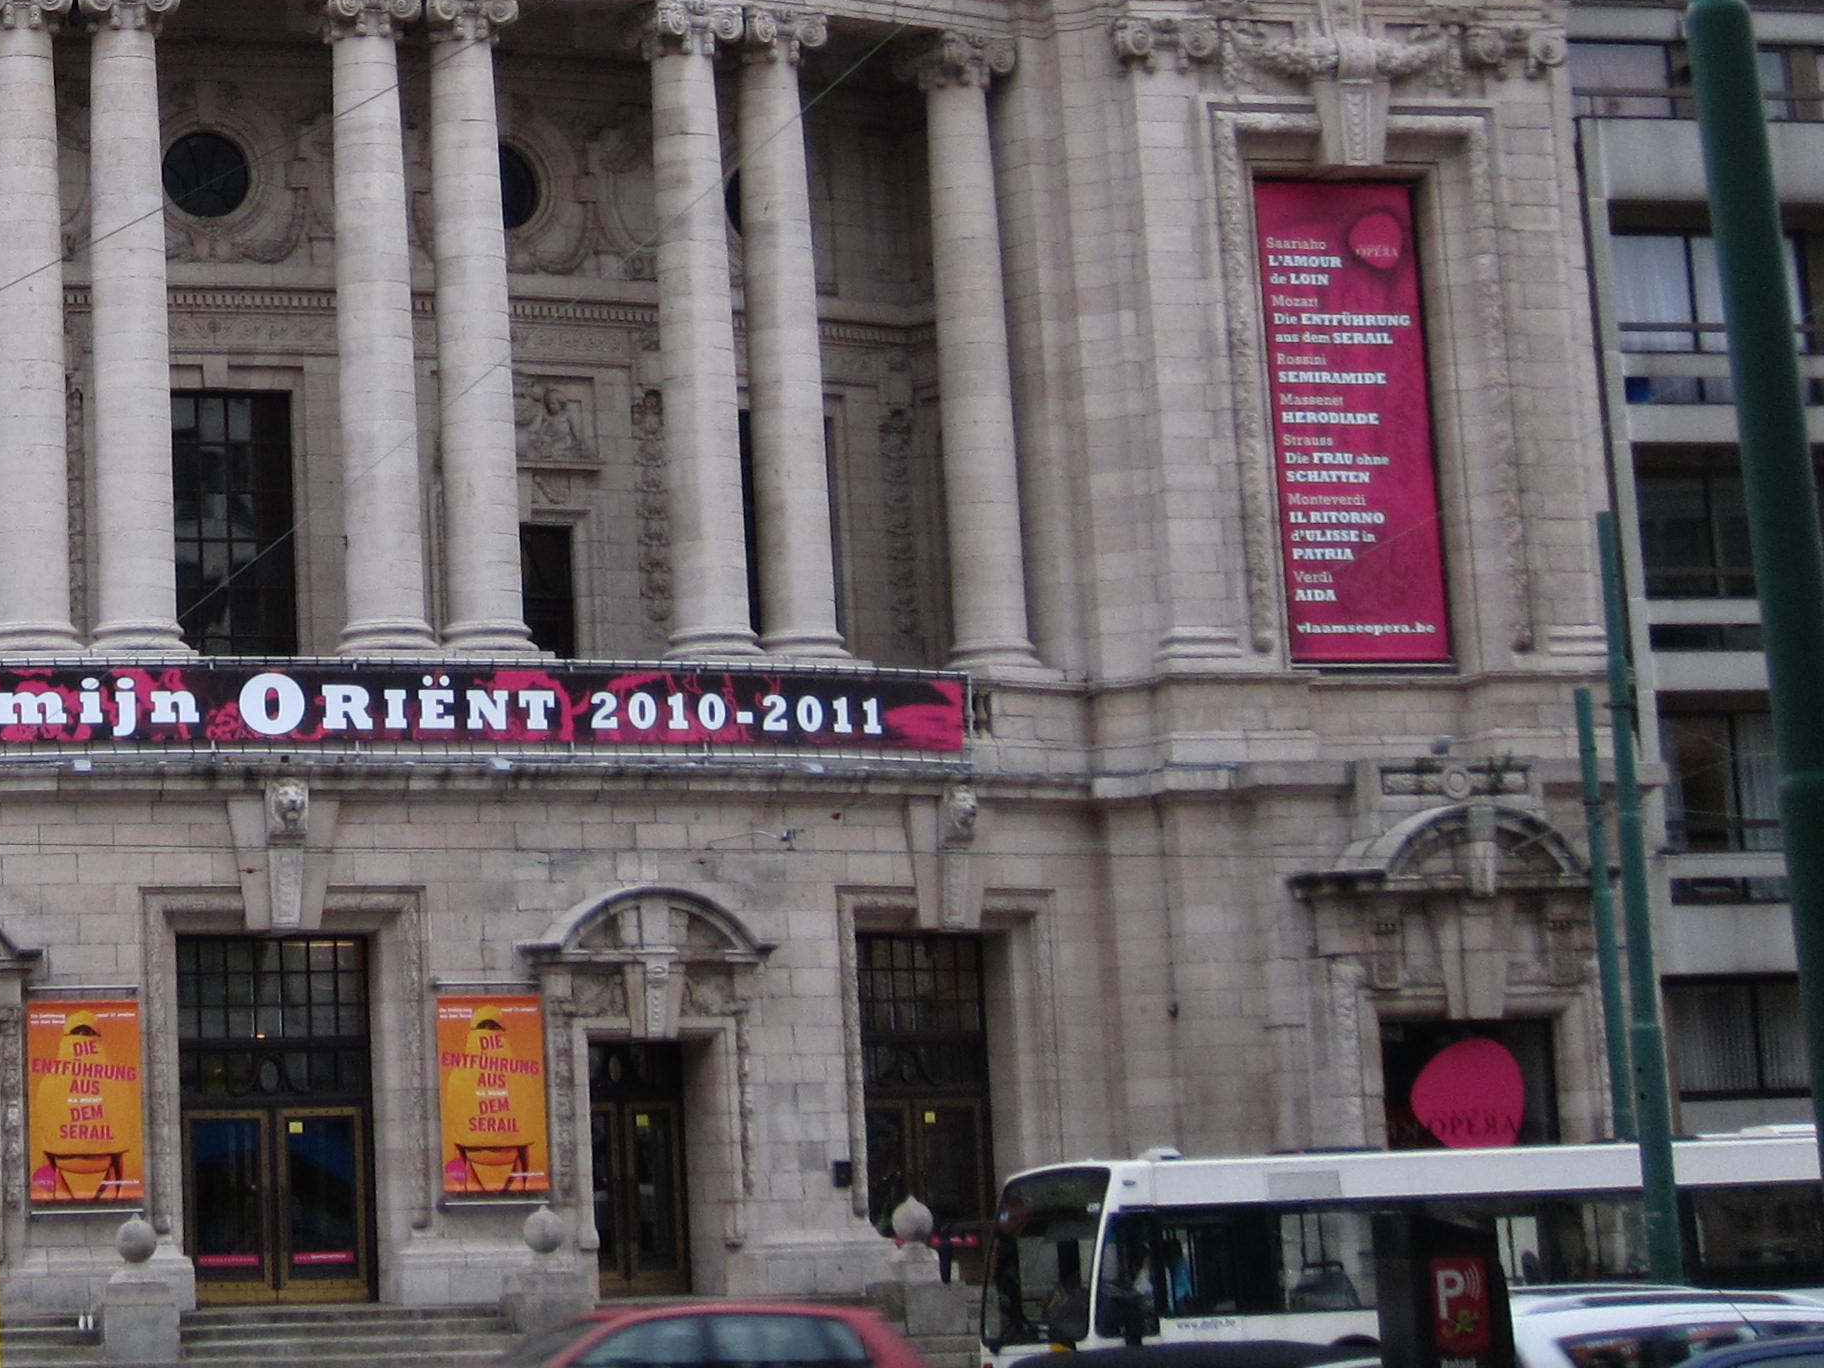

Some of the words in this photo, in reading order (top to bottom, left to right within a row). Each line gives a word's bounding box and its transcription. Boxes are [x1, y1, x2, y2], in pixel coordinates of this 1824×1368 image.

[1266, 237, 1327, 250] Saariaho
[1268, 255, 1343, 268] L'AMOUR
[1270, 273, 1287, 285] de
[1289, 273, 1329, 286] LOIN
[1270, 295, 1319, 308] Mozart
[1273, 313, 1298, 325] Die
[1300, 311, 1411, 326] ENTFÜHRUNG
[1275, 333, 1300, 343] aus
[1302, 331, 1331, 344] dem
[1332, 332, 1393, 344] SERAIL
[1276, 353, 1328, 366] Rossini
[1278, 371, 1387, 384] SEMIRAMIDE
[1280, 393, 1344, 406] Massenet
[1282, 411, 1379, 425] HERODIADE
[1283, 434, 1333, 446] Strauss
[1285, 452, 1310, 464] Die
[1312, 452, 1353, 465] FRAU
[1356, 453, 1390, 466] ohne
[1286, 471, 1370, 483] SCHATTEN
[1288, 493, 1367, 506] Monteverdi
[1289, 511, 1308, 523] IL
[1310, 511, 1386, 524] RITORNO
[1291, 529, 1359, 542] d'ULISSE
[1361, 530, 1376, 542] in
[1292, 548, 1355, 560] PATRIA
[1293, 570, 1333, 583] Verdi
[1295, 589, 1337, 601] AIDA
[1296, 621, 1436, 636] vlaamseopera.be
[238, 672, 556, 735] ORIËNT
[591, 691, 883, 735] 2010-2011
[73, 1039, 99, 1058] DIE
[480, 1034, 504, 1052] DIE
[31, 1058, 137, 1082] ENTFÜHRUNG
[441, 1052, 540, 1076] ENTFÜHRUNG
[69, 1079, 100, 1096] AUS
[477, 1073, 506, 1089] AUS
[479, 1097, 510, 1116] DEM
[70, 1105, 103, 1123] DEM
[468, 1117, 520, 1133] SERAIL
[59, 1124, 114, 1140] SERAIL
[1437, 1269, 1465, 1320] P
